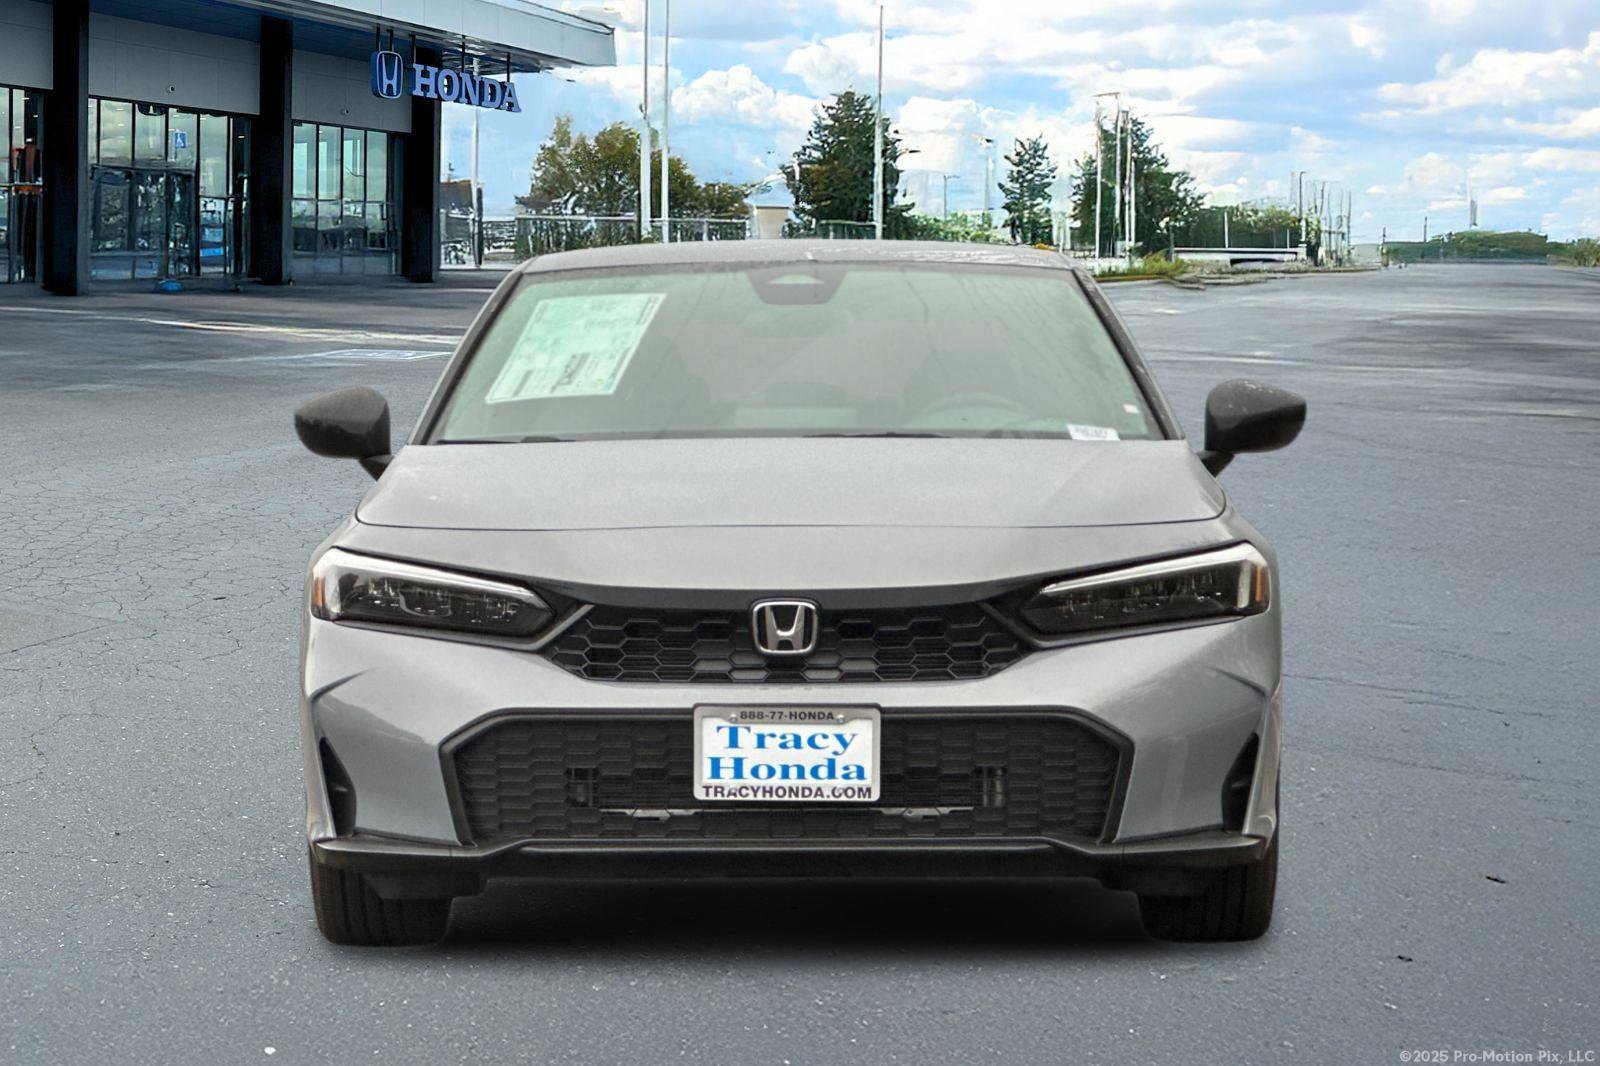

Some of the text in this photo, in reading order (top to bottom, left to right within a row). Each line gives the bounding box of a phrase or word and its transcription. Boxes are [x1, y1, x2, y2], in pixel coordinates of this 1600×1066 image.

[411, 63, 522, 113] HONDA
[739, 711, 834, 721] 888-77-HONDA
[716, 725, 859, 756] Tracy
[706, 756, 867, 781] Honda
[702, 785, 872, 799] TRACYHONDA.COM
